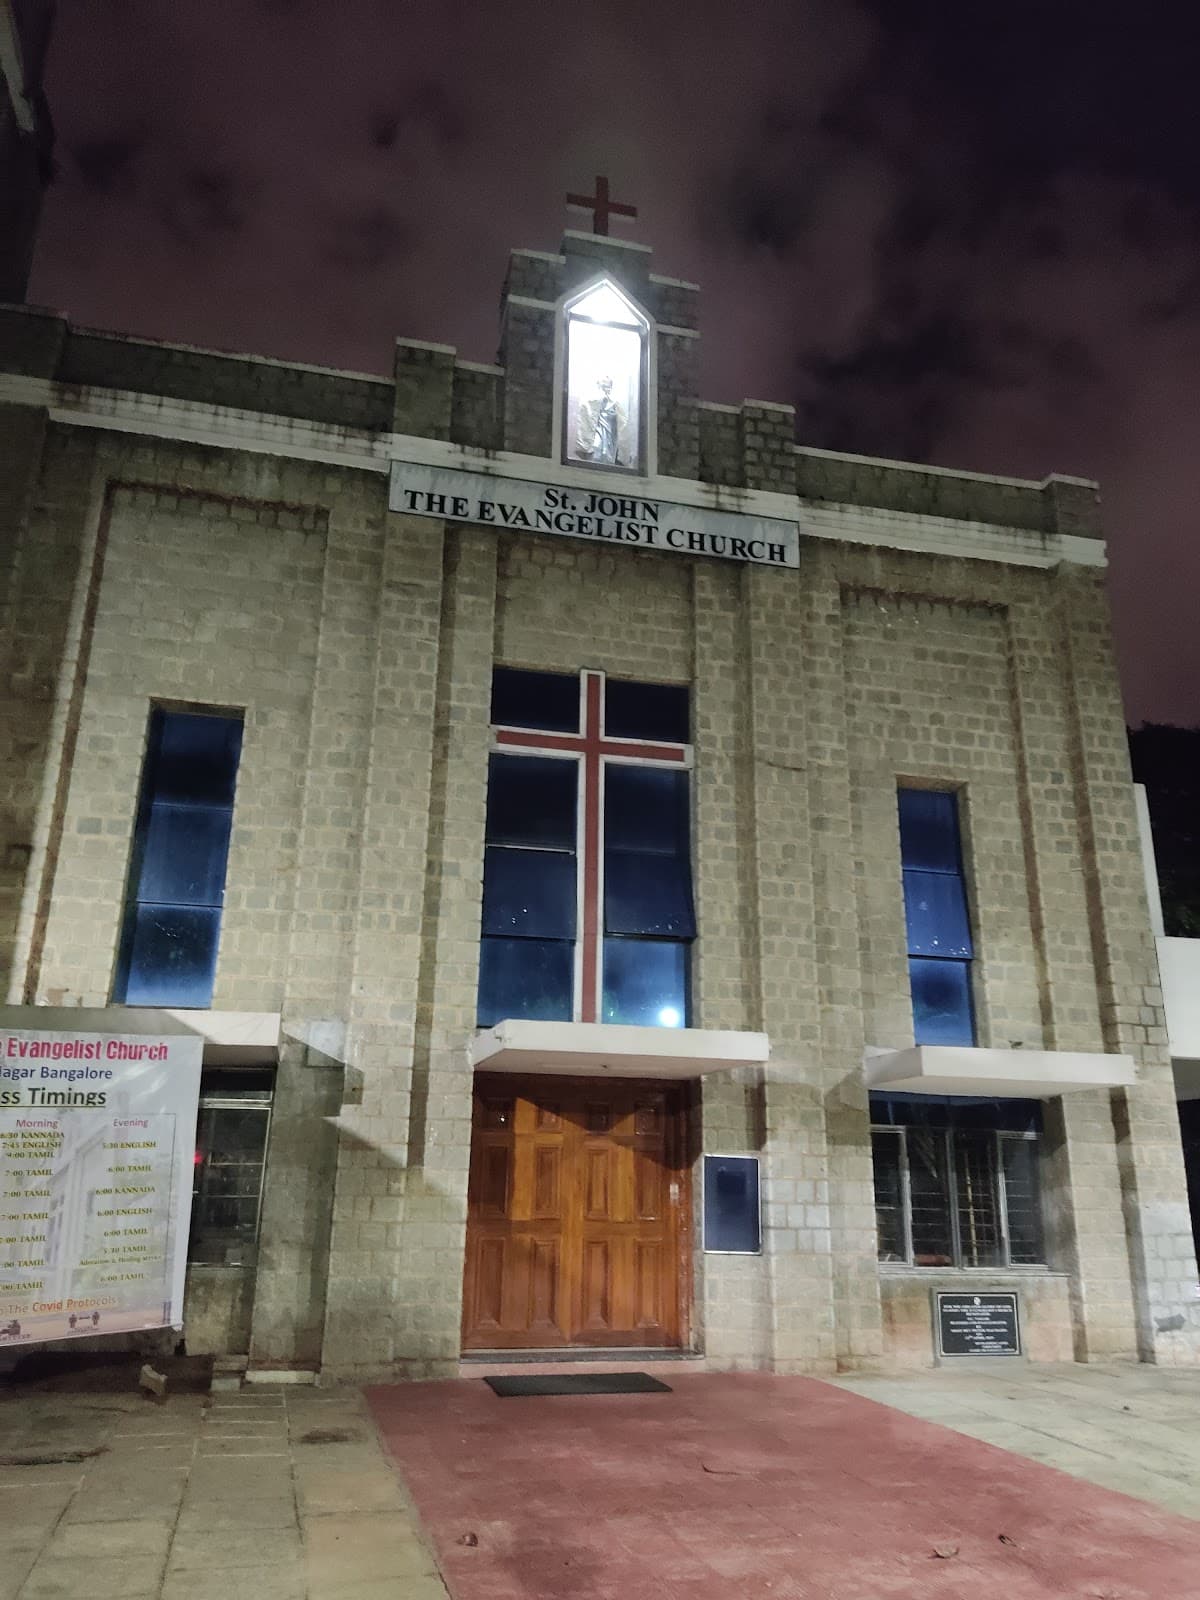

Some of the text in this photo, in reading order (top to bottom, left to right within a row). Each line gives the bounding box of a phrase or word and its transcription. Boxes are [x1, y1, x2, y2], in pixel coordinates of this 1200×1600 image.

[544, 488, 660, 523] St. JOHN
[403, 489, 788, 564] THE EVANGELIST CHURCH
[7, 1037, 101, 1061] Evangelist
[107, 1040, 168, 1061] Church
[40, 1066, 113, 1081] Bangalore
[28, 1087, 107, 1106] Timings
[16, 1119, 59, 1130] Morning
[113, 1118, 149, 1129] Evening
[21, 1131, 65, 1139] KANNADA
[22, 1140, 62, 1149] ENGLISH
[120, 1141, 157, 1149] ENGLISH
[28, 1151, 56, 1159] TAMIL
[25, 1168, 54, 1177] TAMIL
[127, 1164, 152, 1172] TAMIL
[23, 1190, 52, 1198] TAMIL
[114, 1186, 156, 1194] KANNADA
[23, 1211, 49, 1220] TAMIL
[116, 1207, 153, 1216] ENGLISH
[123, 1227, 148, 1236] TAMIL
[20, 1234, 47, 1243] TAMIL
[122, 1245, 147, 1254] TAMIL
[17, 1258, 45, 1268] TAMIL
[120, 1272, 145, 1281] TAMIL
[15, 1281, 44, 1290] TAMIL
[9, 1303, 29, 1314] The
[32, 1301, 63, 1313] Covid
[66, 1296, 117, 1310] Protocols
